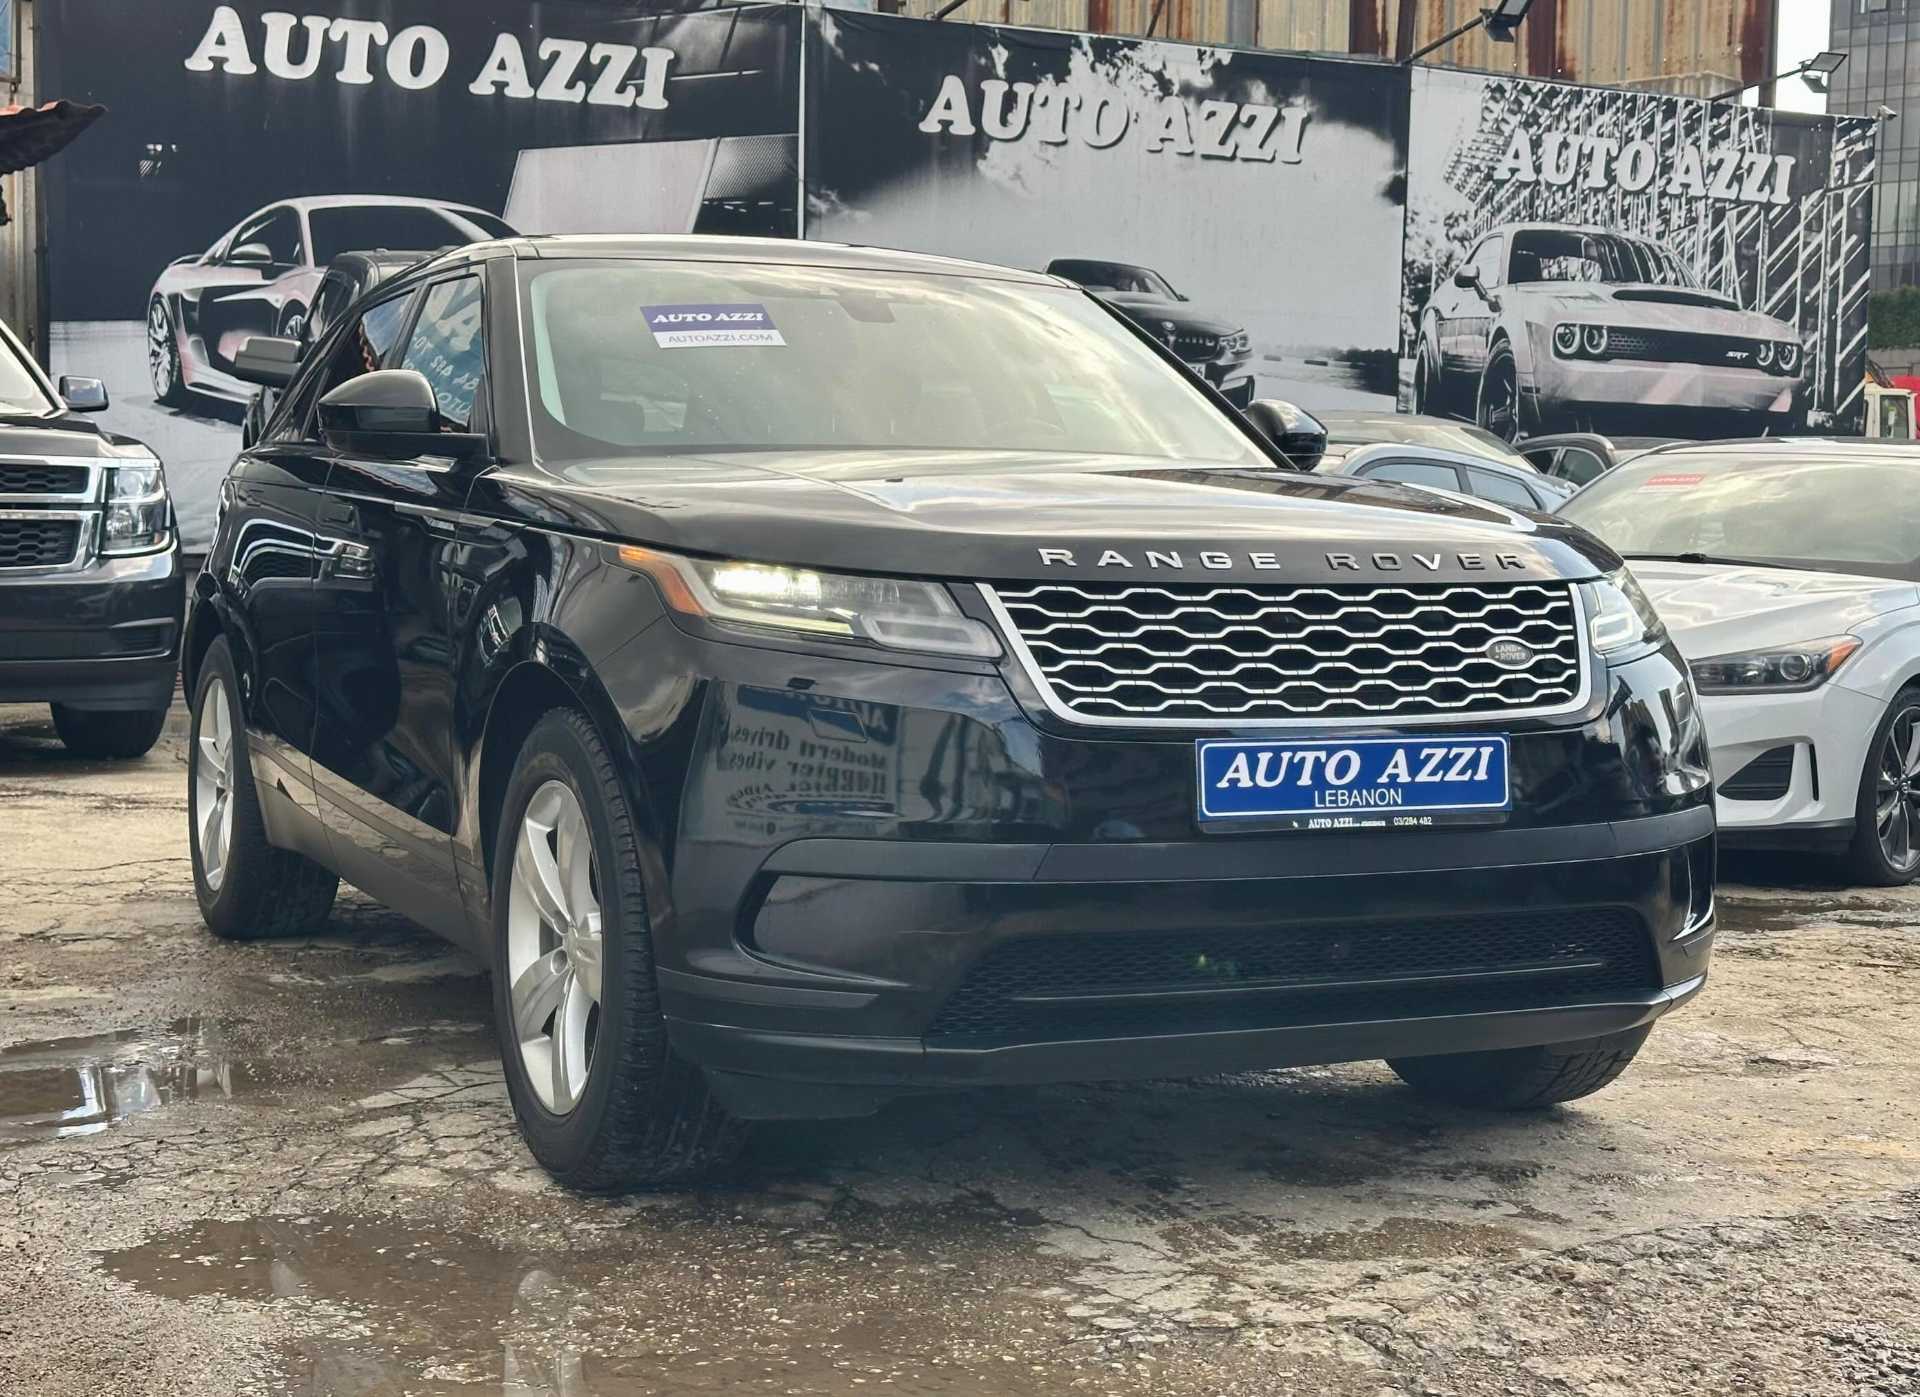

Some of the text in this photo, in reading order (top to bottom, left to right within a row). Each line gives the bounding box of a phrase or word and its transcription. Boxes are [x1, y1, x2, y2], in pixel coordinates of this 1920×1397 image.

[184, 5, 676, 111] AUTO AZZI
[918, 75, 1311, 163] AUTO AZZI
[1493, 128, 1796, 204] AUTO AZZI
[652, 312, 764, 323] AUTO AZZI
[1038, 548, 1526, 570] RANGE ROVER
[1216, 746, 1494, 788] AUTO AZZI
[1314, 788, 1402, 808] LEBANON
[1308, 818, 1331, 829] AUTO
[1333, 817, 1353, 828] AZZI
